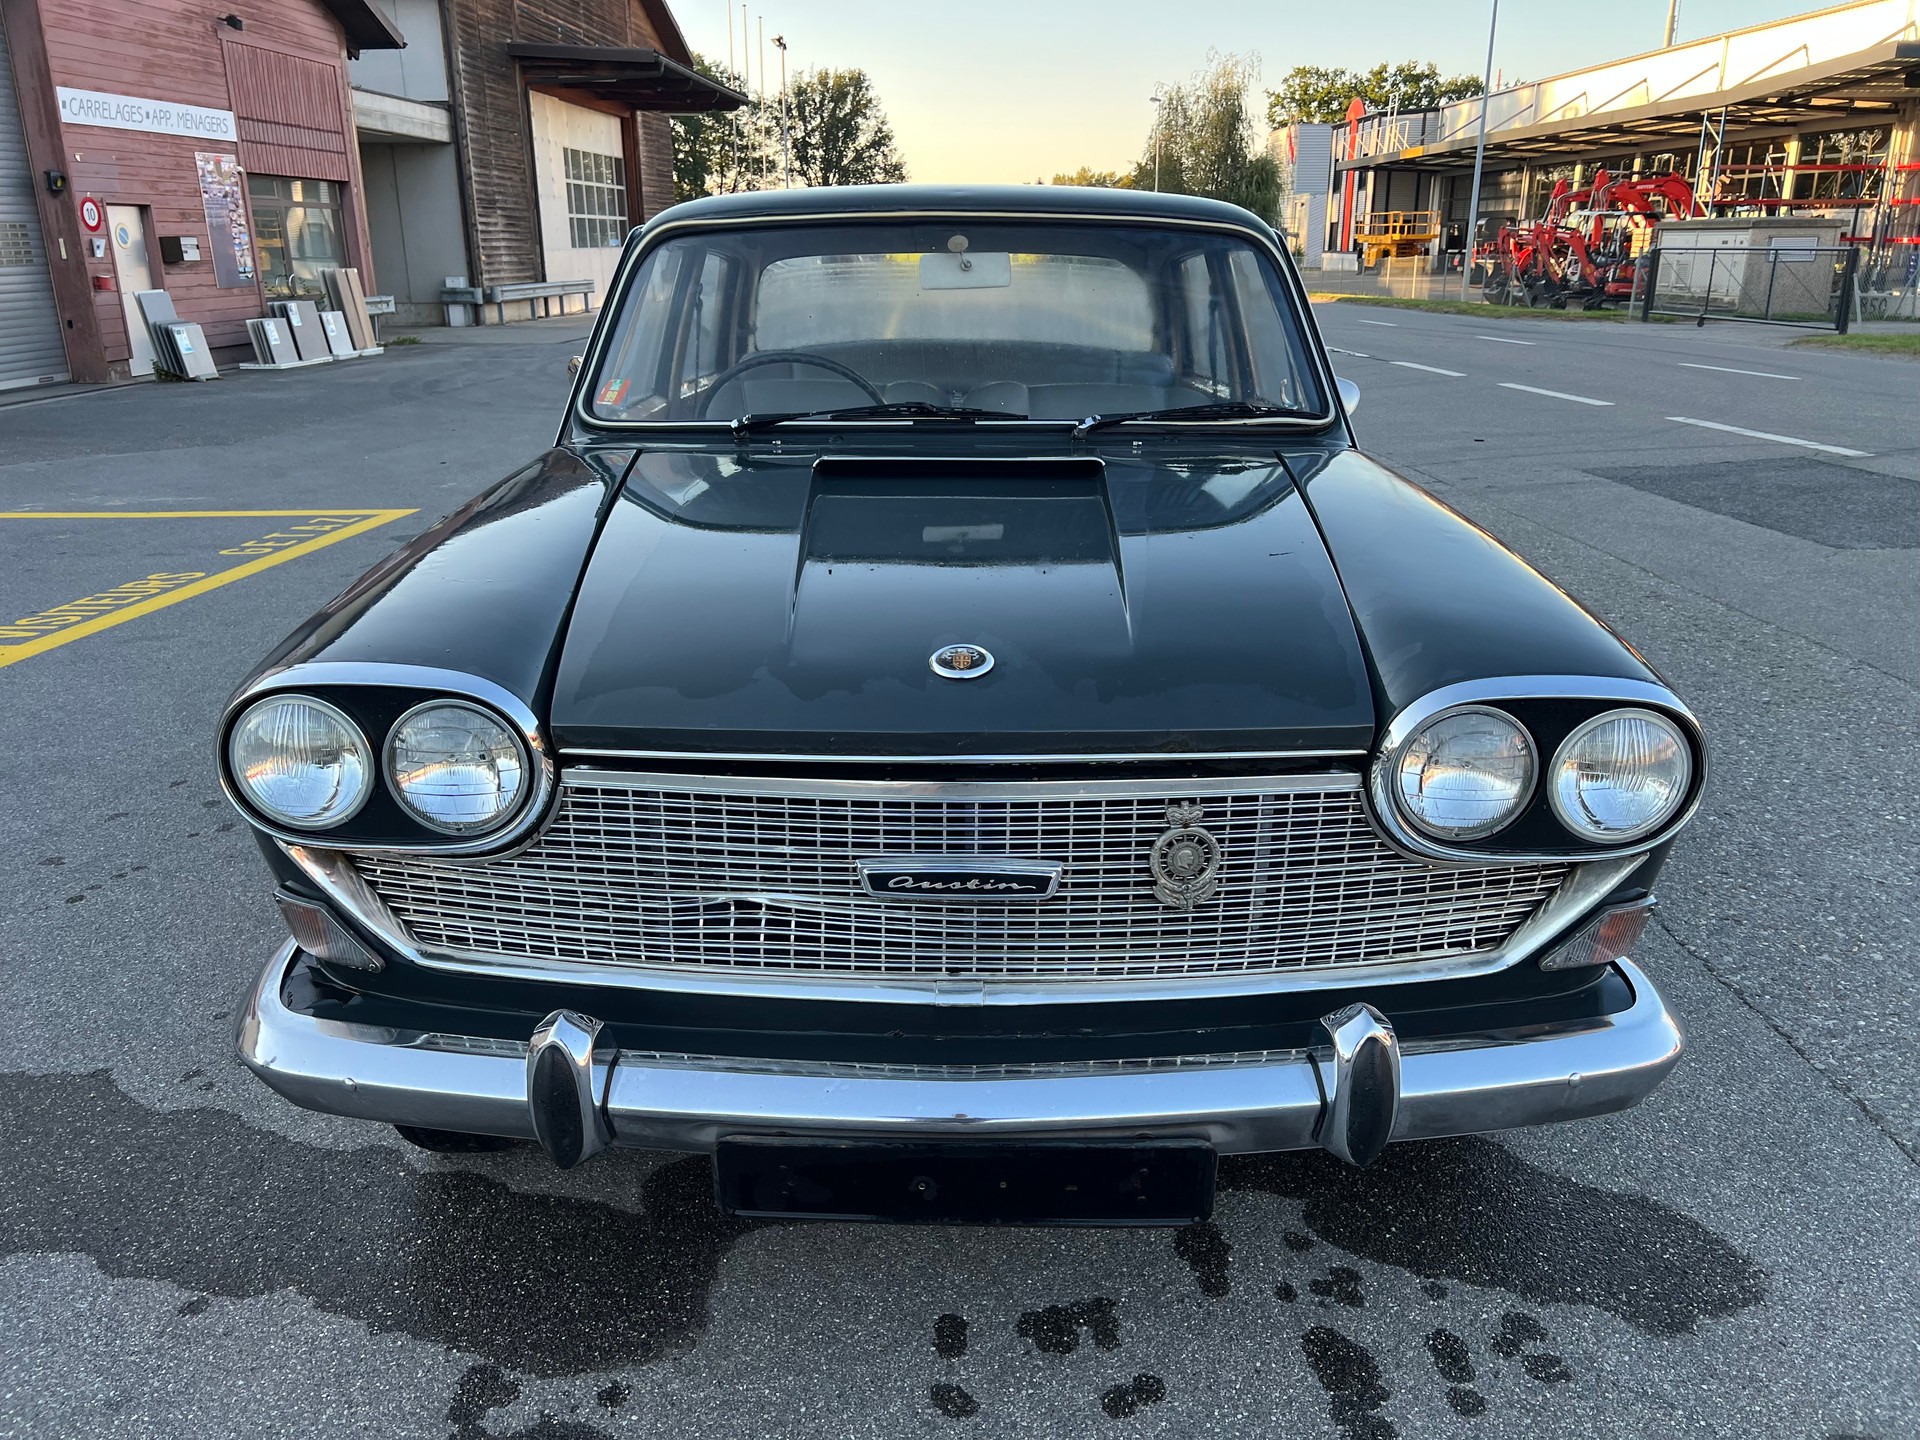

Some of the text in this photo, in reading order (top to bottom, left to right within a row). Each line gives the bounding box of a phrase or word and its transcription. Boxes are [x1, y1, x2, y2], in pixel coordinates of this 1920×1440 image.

[68, 97, 229, 134] CARRELAGES APP. MÉNAGERS
[86, 207, 96, 221] 10
[218, 516, 363, 555] GETAZ
